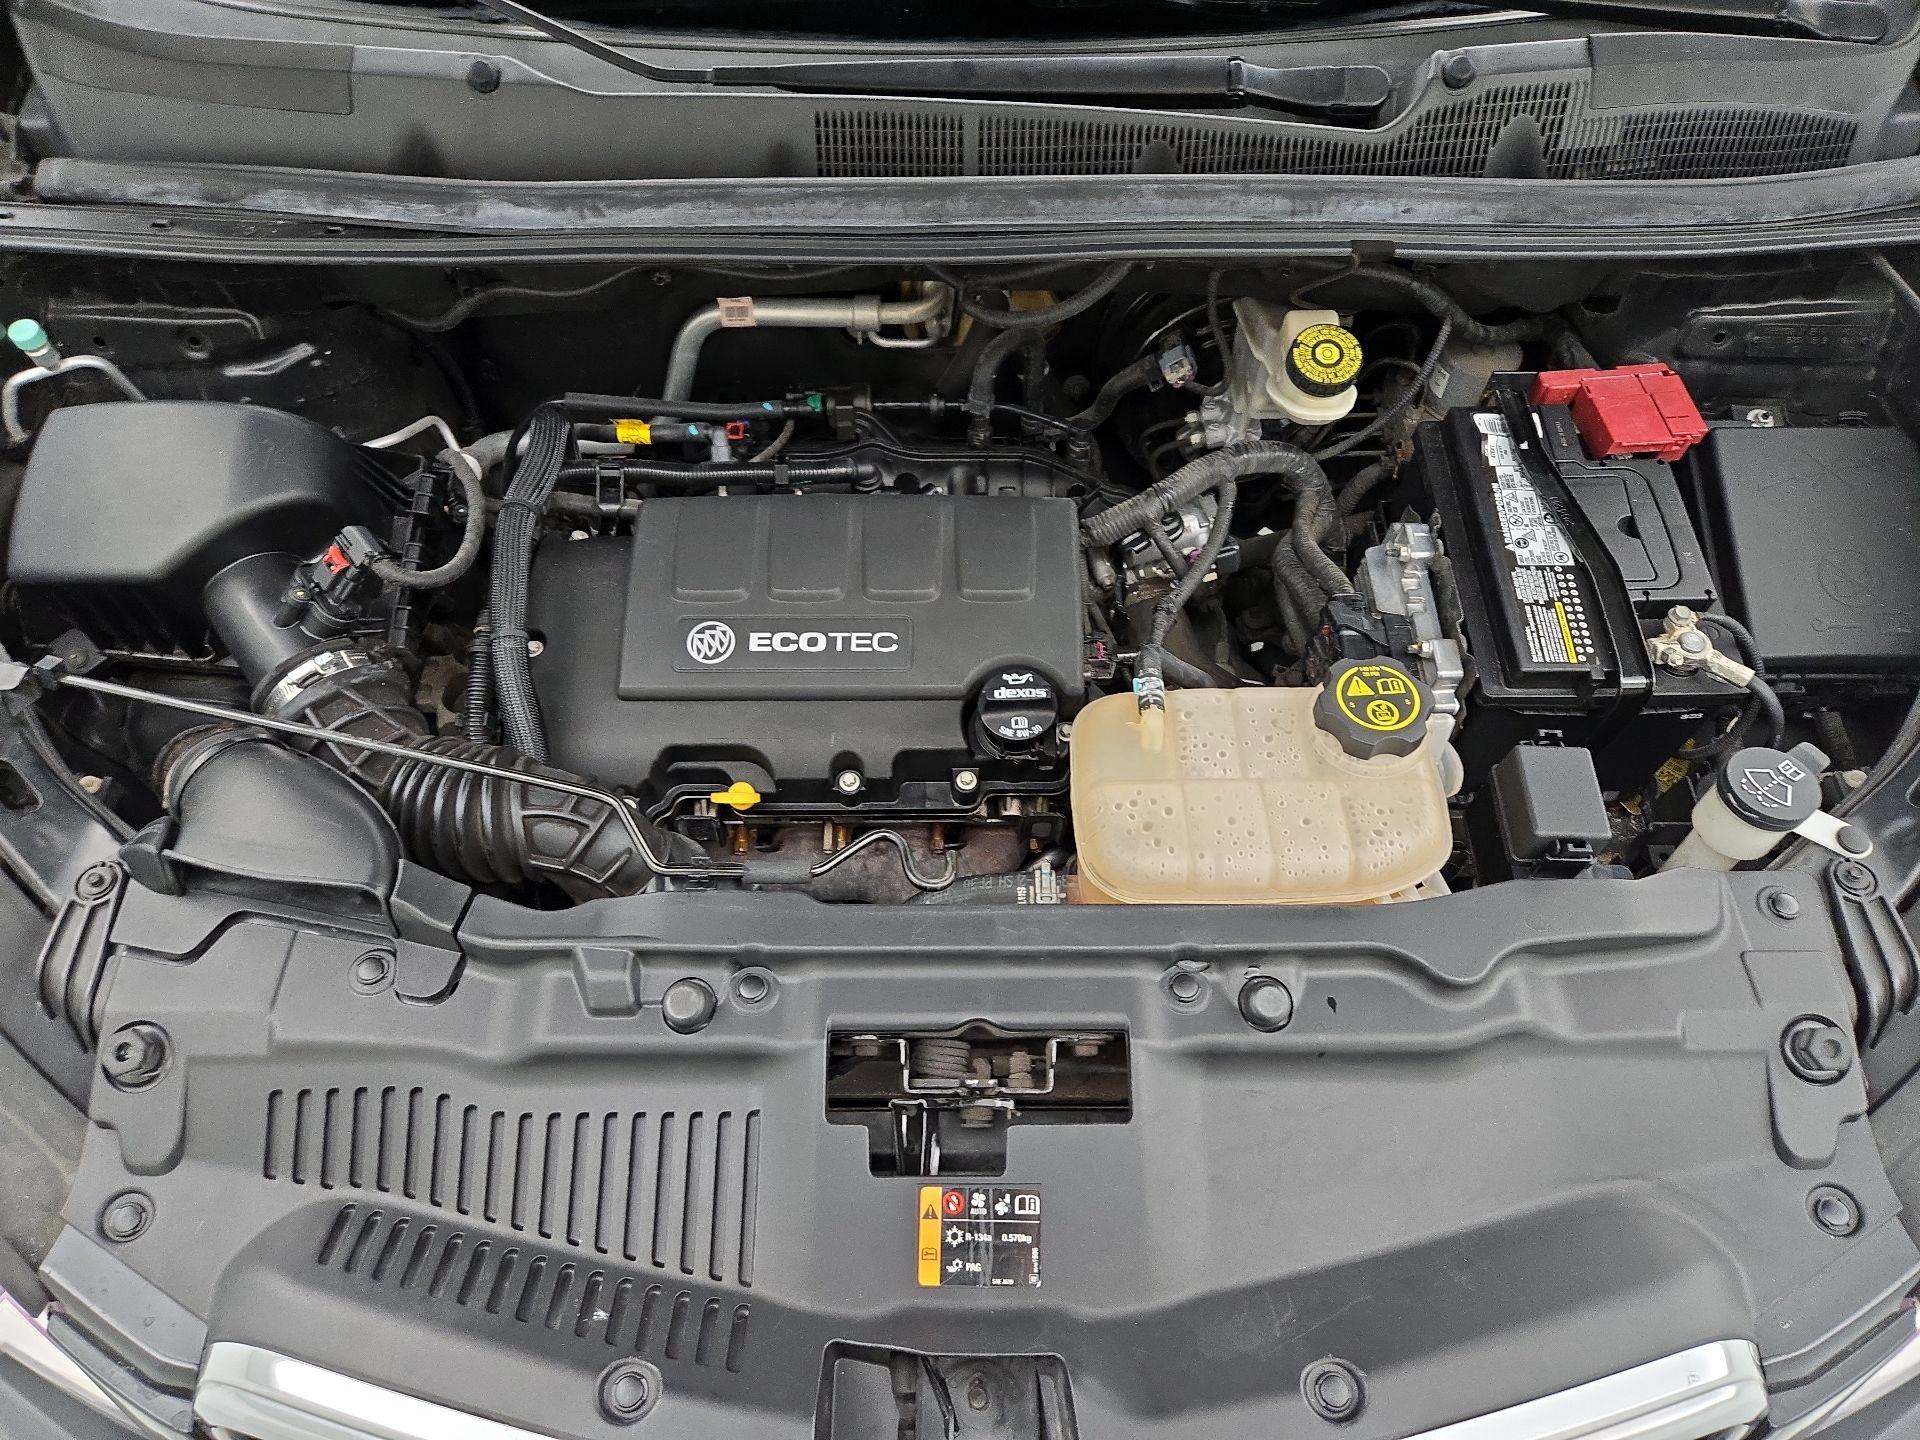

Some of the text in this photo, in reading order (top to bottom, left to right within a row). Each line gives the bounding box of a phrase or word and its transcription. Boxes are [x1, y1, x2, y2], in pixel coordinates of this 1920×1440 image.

[748, 632, 899, 652] ECOTEC
[993, 686, 1047, 699] dexos
[965, 1232, 992, 1242] R-134a
[965, 1262, 982, 1272] PAG
